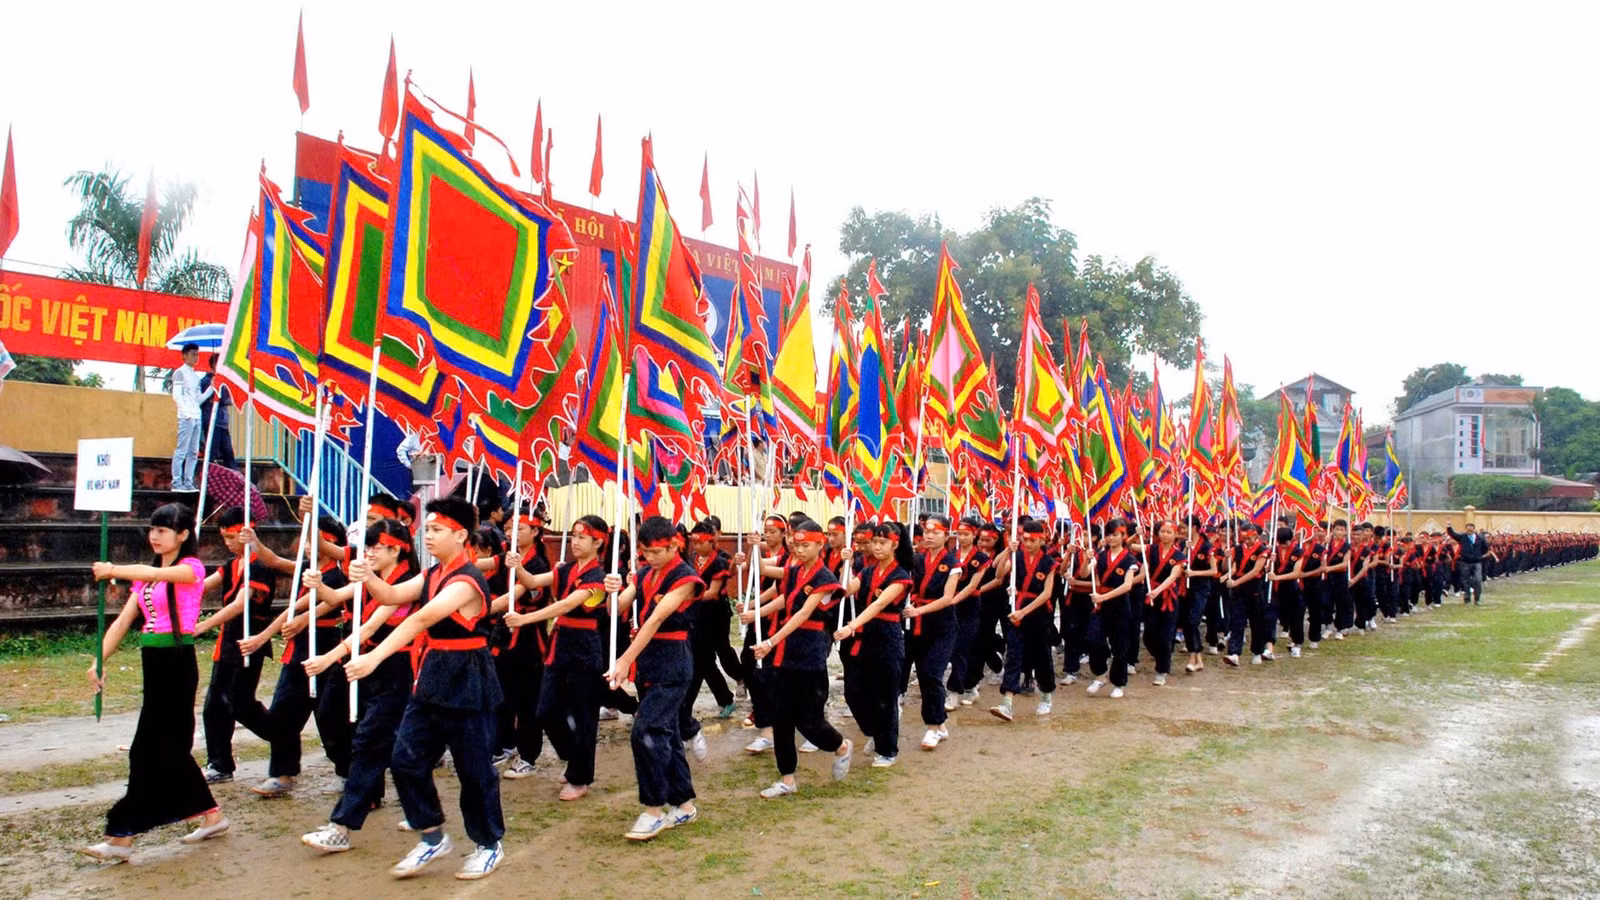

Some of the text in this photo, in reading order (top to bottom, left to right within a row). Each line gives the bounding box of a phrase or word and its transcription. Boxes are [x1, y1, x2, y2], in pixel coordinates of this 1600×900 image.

[575, 215, 605, 240] HỘI
[41, 295, 108, 346] VIỆT
[115, 309, 168, 349] NAM
